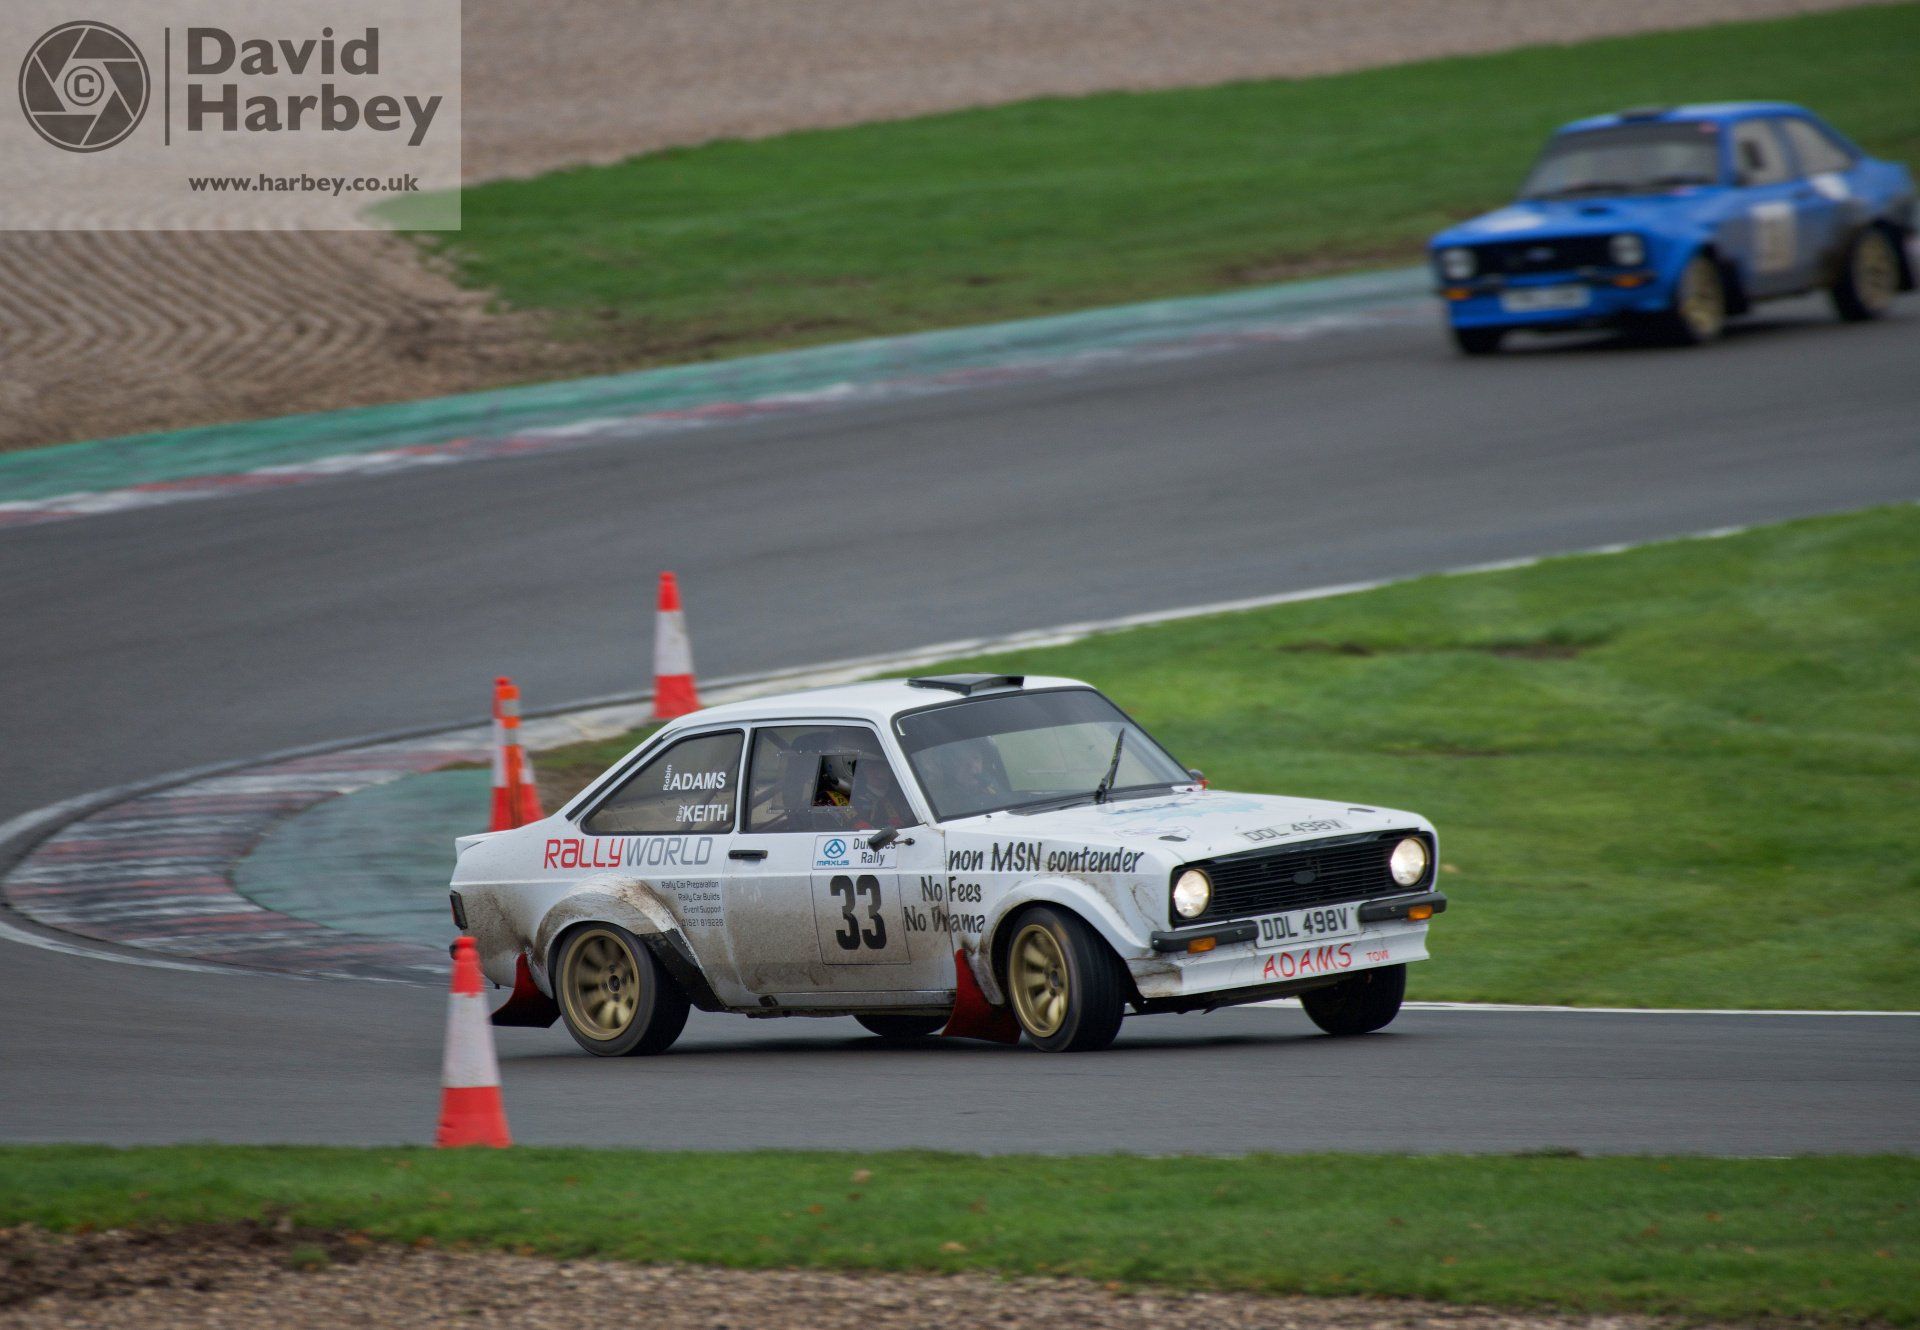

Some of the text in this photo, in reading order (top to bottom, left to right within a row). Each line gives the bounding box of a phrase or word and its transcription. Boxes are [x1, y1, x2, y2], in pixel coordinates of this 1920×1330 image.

[669, 771, 726, 791] ADAMS
[682, 804, 728, 822] KEITH
[1243, 818, 1343, 842] DDL 498V
[861, 851, 886, 866] Rally
[948, 841, 1145, 873] non MSN contender
[661, 881, 676, 890] Rally
[677, 881, 686, 889] Car
[693, 893, 702, 901] Car
[703, 893, 720, 901] Builds
[920, 875, 982, 902] No Fees
[829, 874, 888, 951] 33
[903, 905, 986, 933] No Drama
[1260, 908, 1349, 941] DDL 498V
[1263, 943, 1353, 979] ADAMS
